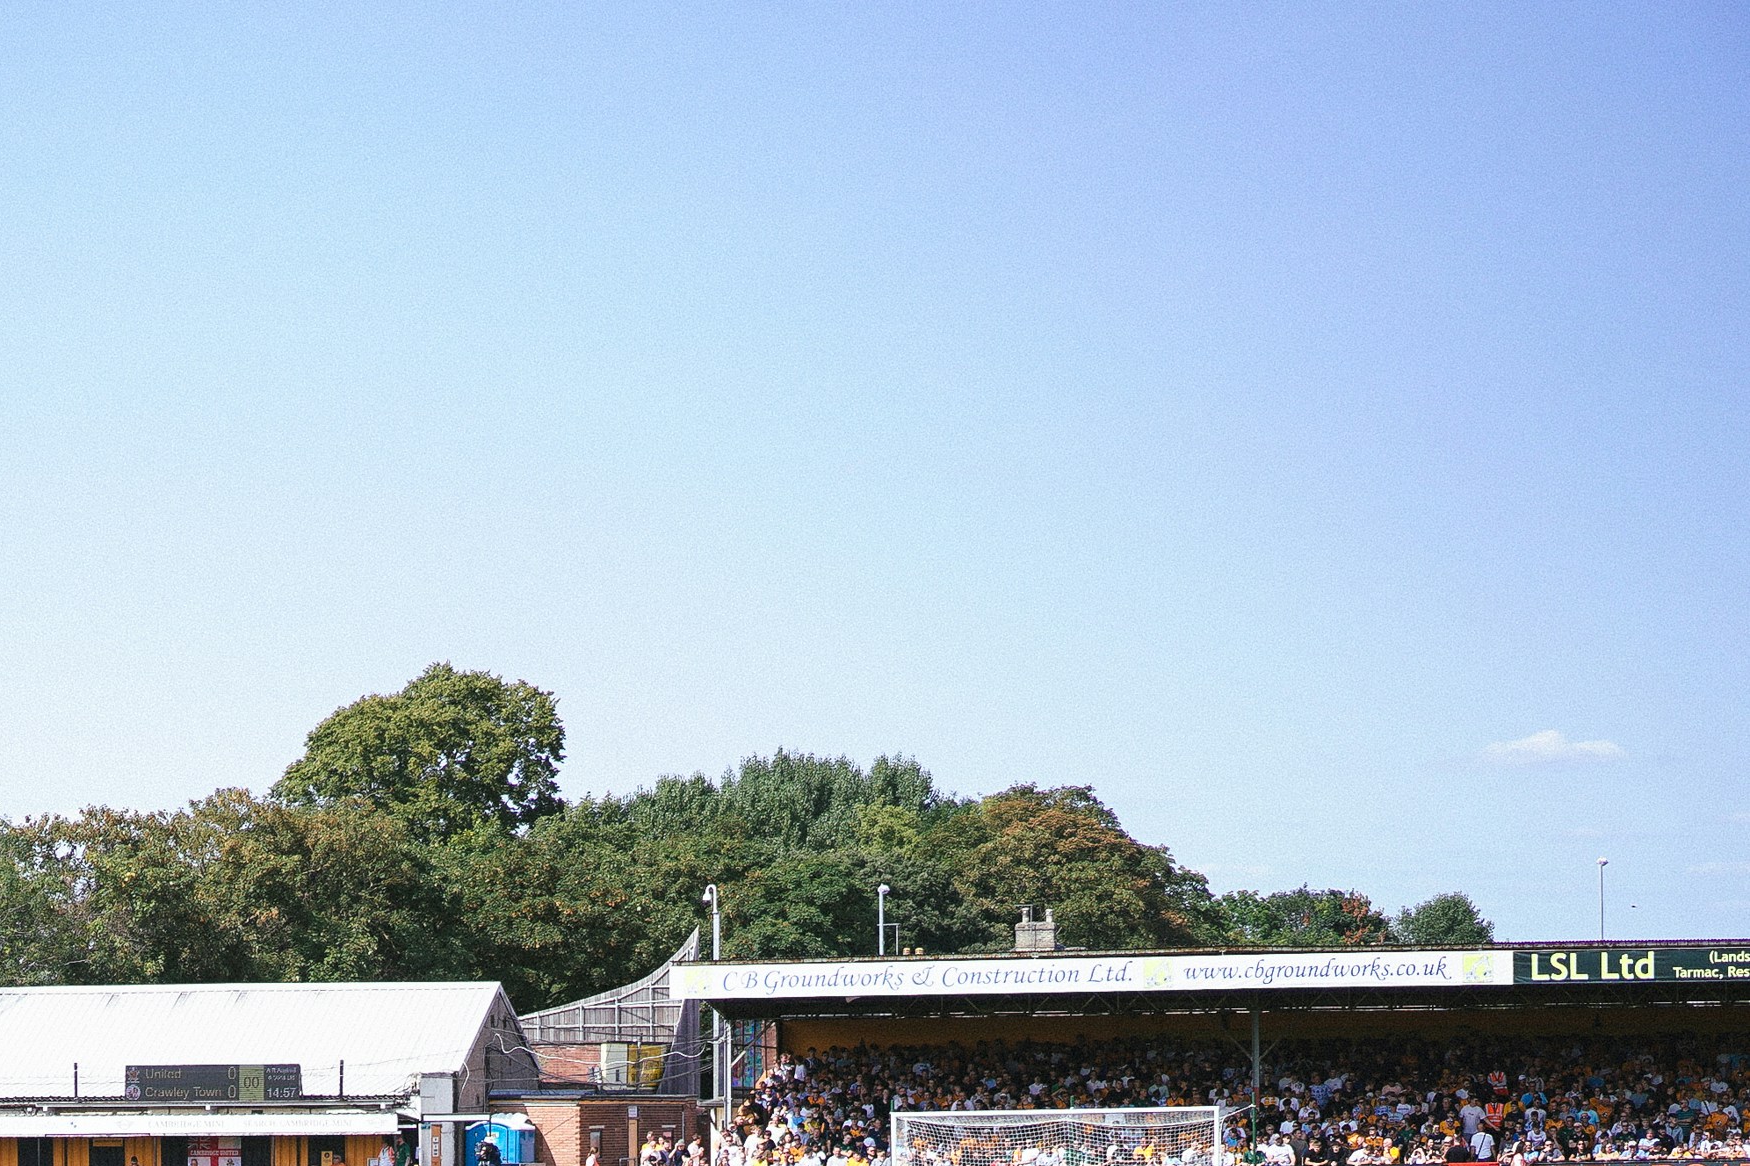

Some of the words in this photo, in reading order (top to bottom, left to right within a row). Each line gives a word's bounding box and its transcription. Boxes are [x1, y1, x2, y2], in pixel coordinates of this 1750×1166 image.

[1183, 956, 1452, 985] www.cbgroundworks.co.uk
[1530, 951, 1589, 981] LSL
[1600, 951, 1655, 980] Ltd
[1673, 966, 1724, 980] Tarmac,
[1728, 965, 1750, 978] Res
[723, 971, 737, 991] C
[741, 970, 758, 989] B
[764, 964, 905, 995] Groundworks
[912, 964, 936, 987] &
[941, 963, 1080, 987] Construction
[1086, 960, 1133, 984] Ltd.
[145, 1068, 181, 1079] United
[227, 1066, 237, 1080] 0
[145, 1086, 189, 1100] Crawley
[193, 1086, 222, 1098] Town
[227, 1085, 237, 1099] 0
[266, 1087, 297, 1098] 14:57
